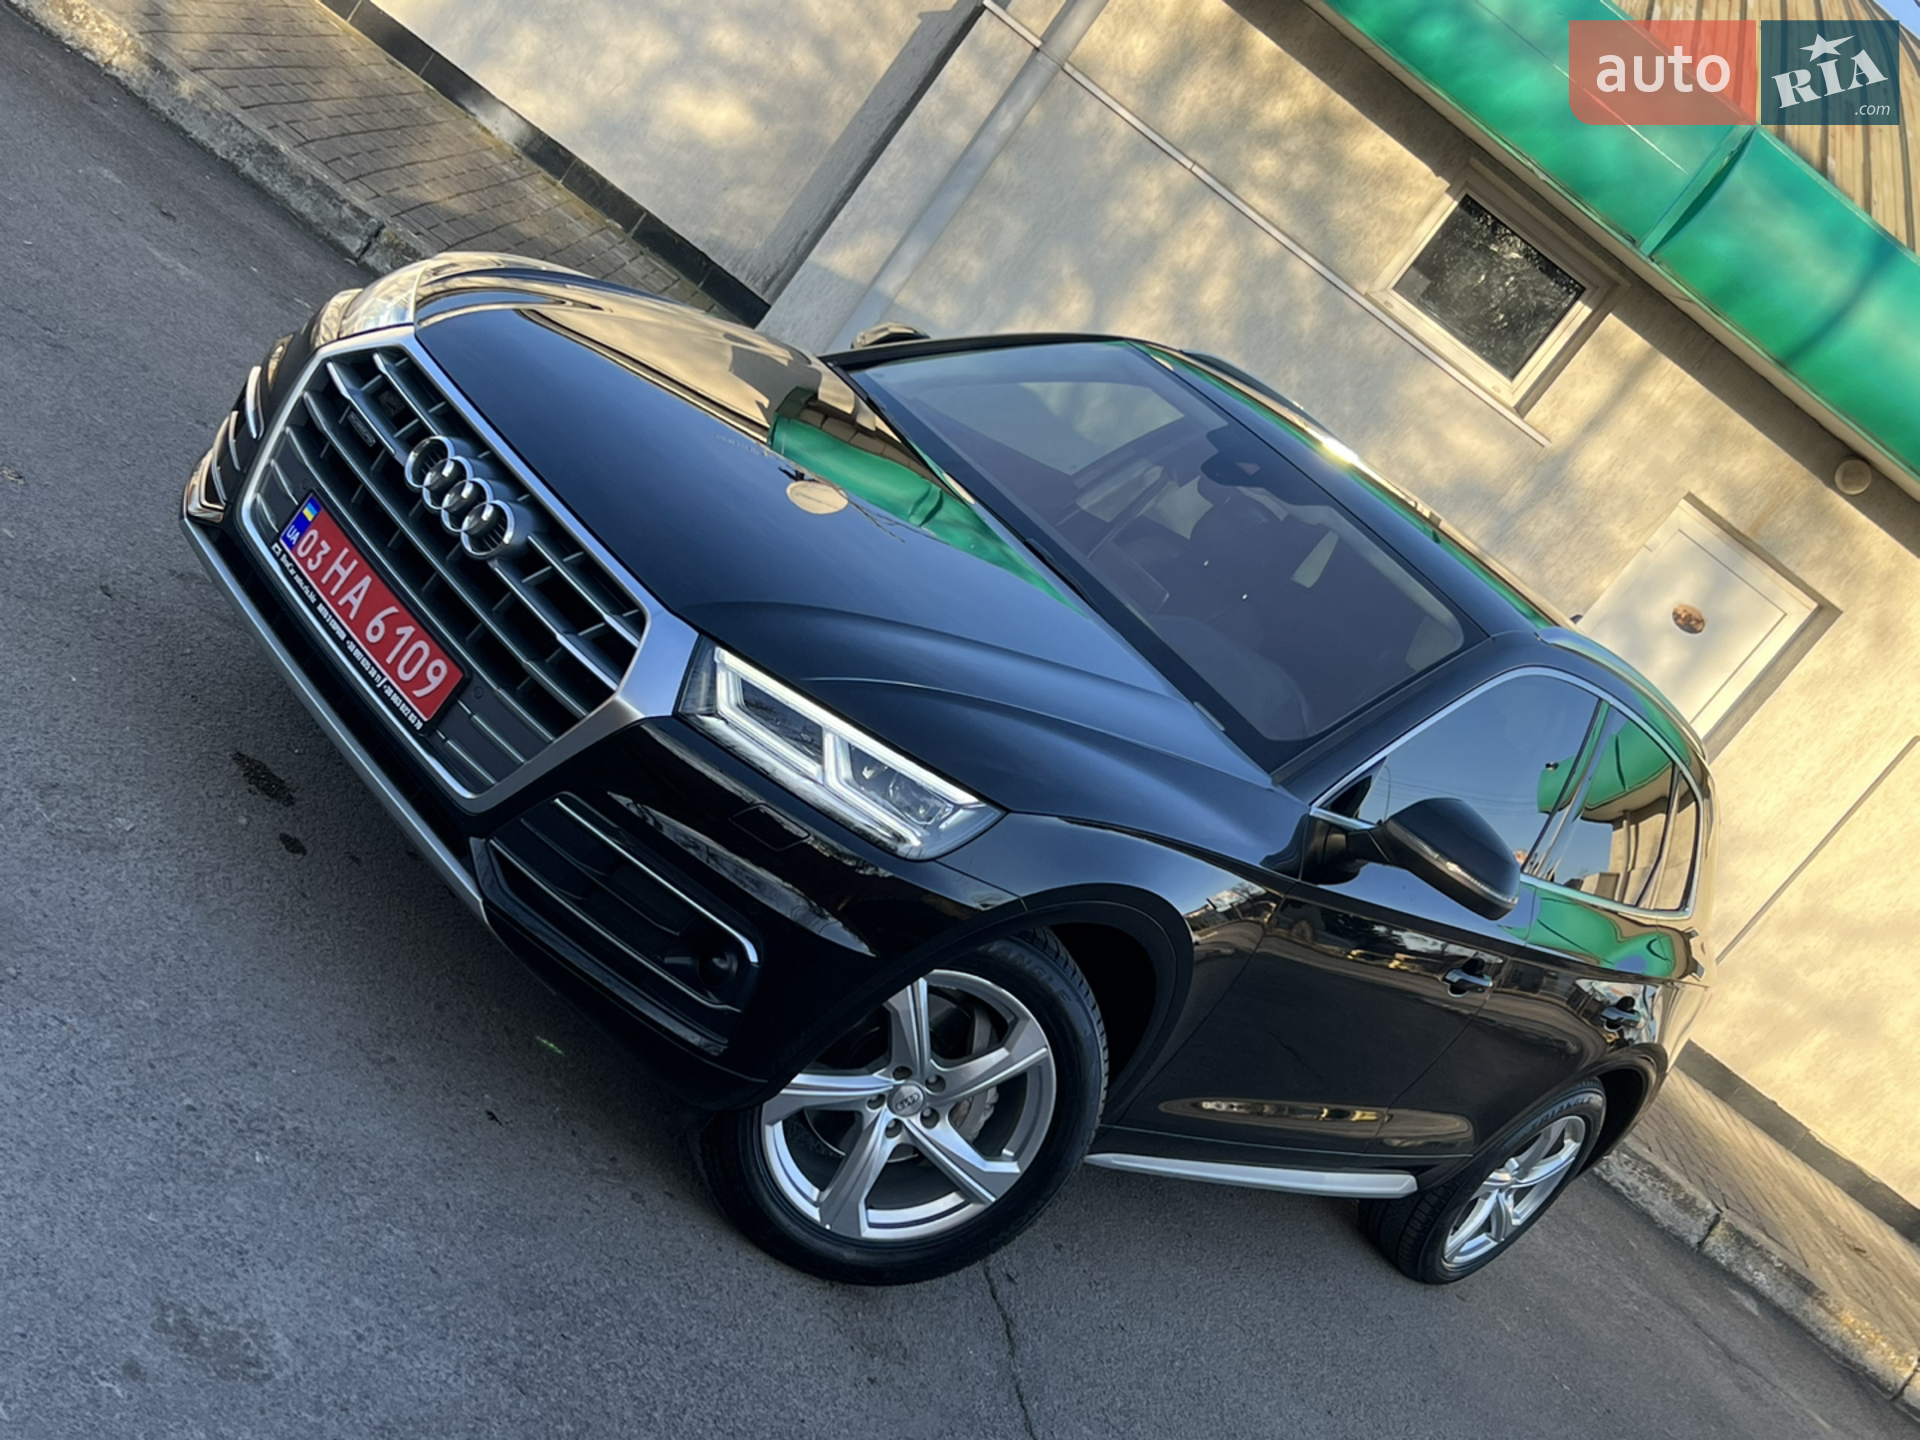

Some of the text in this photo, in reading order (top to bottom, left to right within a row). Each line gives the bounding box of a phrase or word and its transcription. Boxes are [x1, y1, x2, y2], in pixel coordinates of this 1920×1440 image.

[285, 524, 301, 546] UA
[296, 529, 331, 571] 03
[321, 547, 373, 620] HA
[365, 606, 448, 698] 6109
